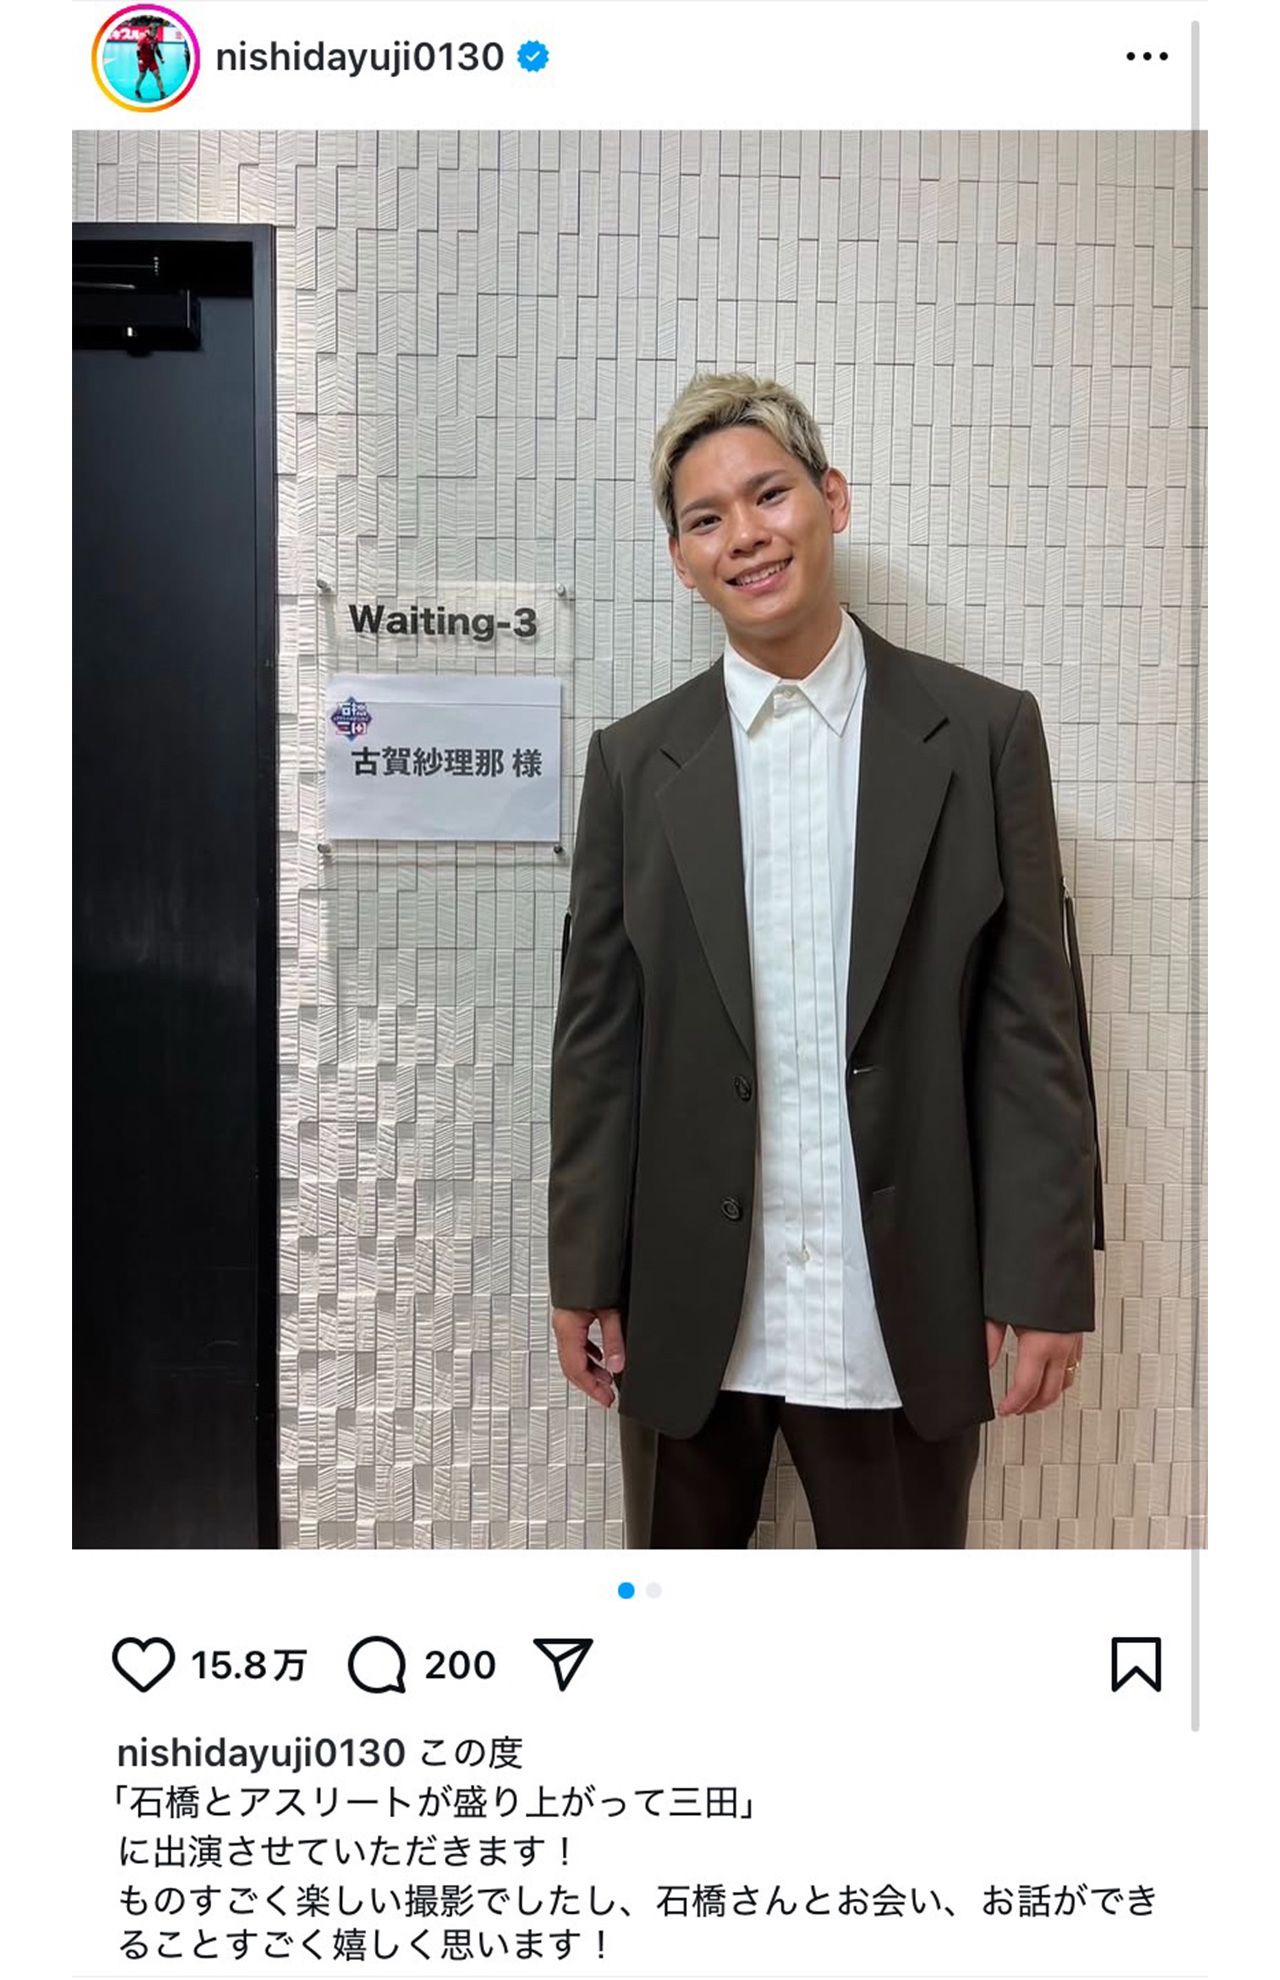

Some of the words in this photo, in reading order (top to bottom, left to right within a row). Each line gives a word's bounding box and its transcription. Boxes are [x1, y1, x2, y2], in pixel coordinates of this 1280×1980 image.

[348, 604, 537, 641] Waiting-3
[351, 746, 504, 778] 古賀紗理那
[512, 748, 542, 778] 様
